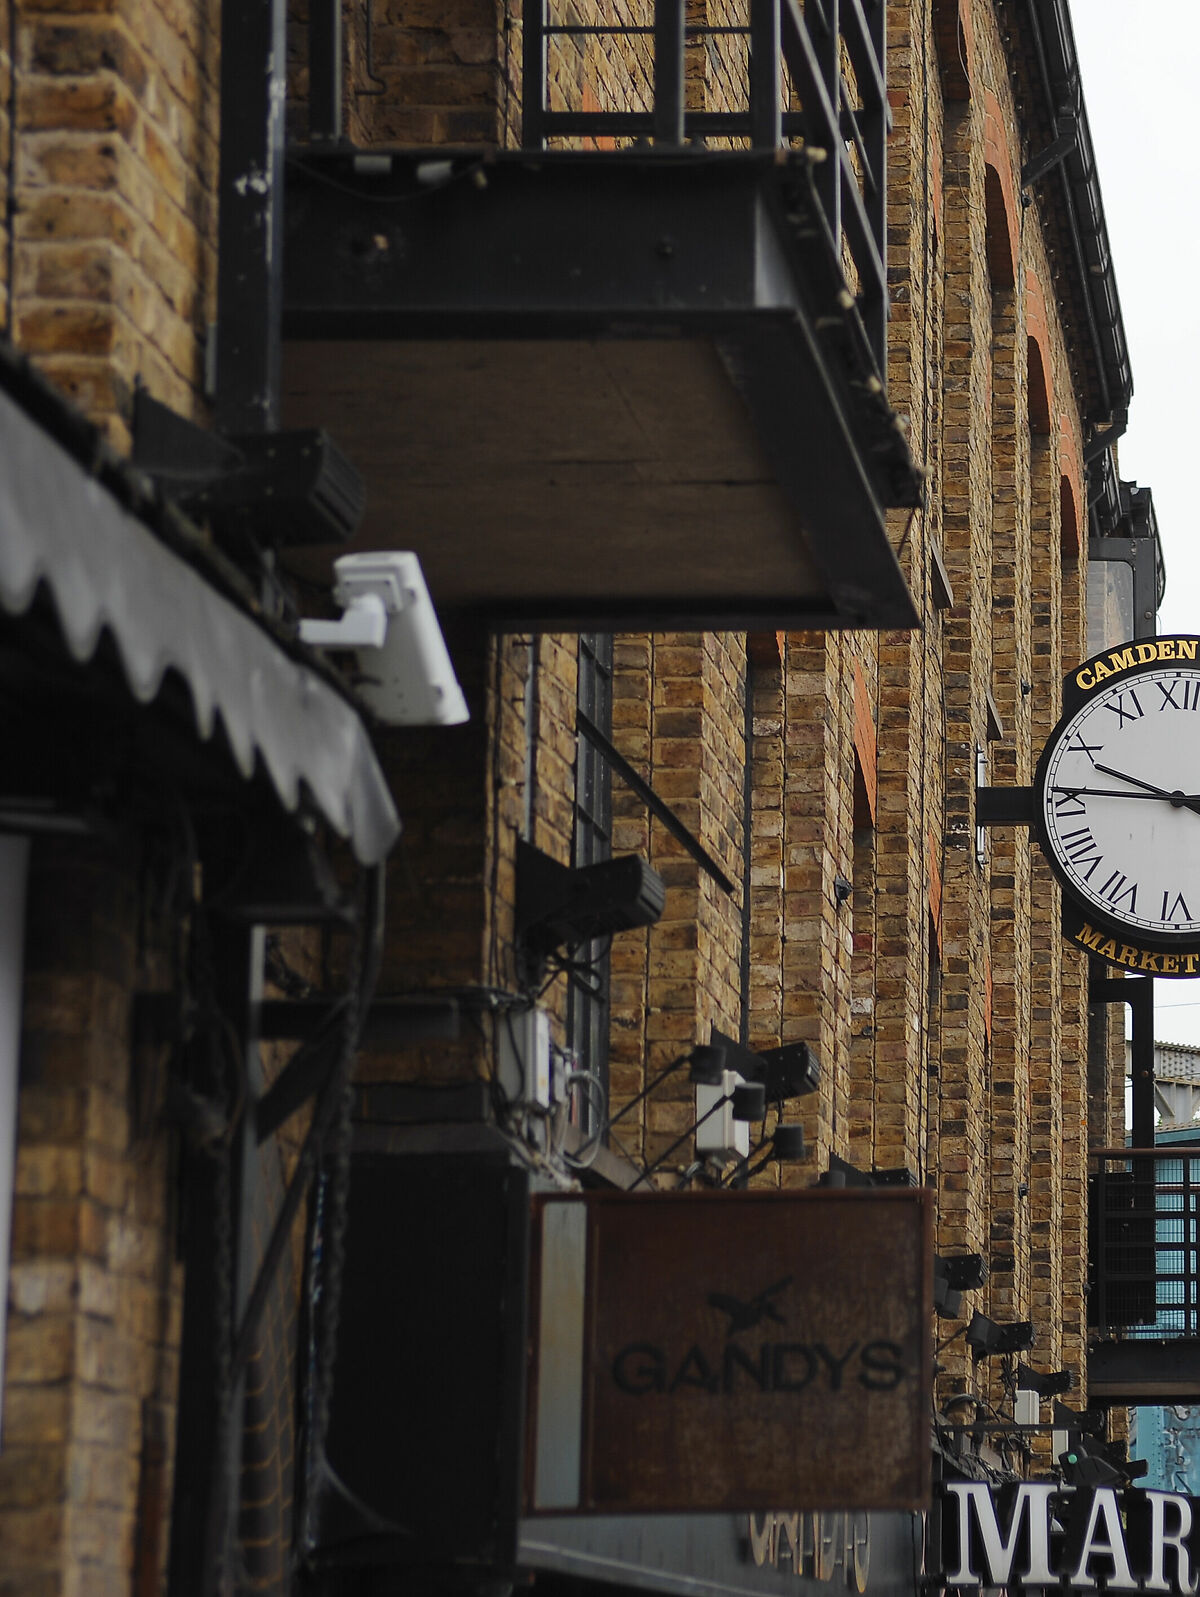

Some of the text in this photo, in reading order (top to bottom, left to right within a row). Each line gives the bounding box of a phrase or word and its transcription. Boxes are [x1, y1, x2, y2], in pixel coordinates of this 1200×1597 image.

[1076, 640, 1199, 690] CAMDEN
[1074, 923, 1199, 973] MARKET
[611, 1339, 904, 1395] GANDYS
